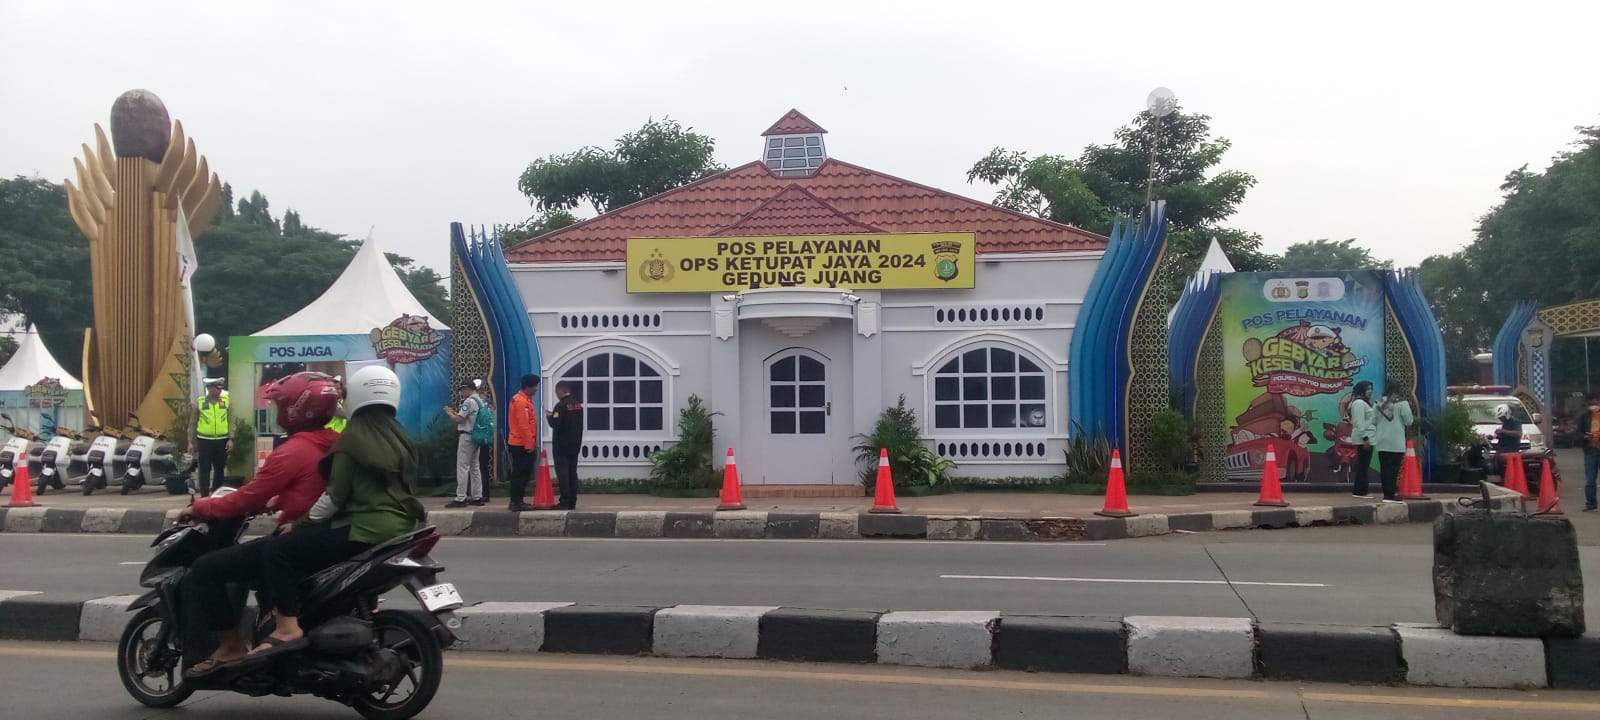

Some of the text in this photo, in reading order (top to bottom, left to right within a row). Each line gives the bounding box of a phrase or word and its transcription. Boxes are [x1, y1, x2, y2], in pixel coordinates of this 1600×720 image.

[717, 240, 881, 256] POS PELAYANAN
[679, 253, 927, 271] OPS KETUPAT JAYA 2024
[722, 270, 882, 286] GEDUNG JUANG
[1242, 309, 1367, 330] POS PELAYANAN
[269, 346, 333, 357] POS JAGA
[1263, 338, 1341, 368] GEBYAR
[1251, 359, 1360, 379] KESELAMATAN
[1297, 376, 1320, 387] METRO
